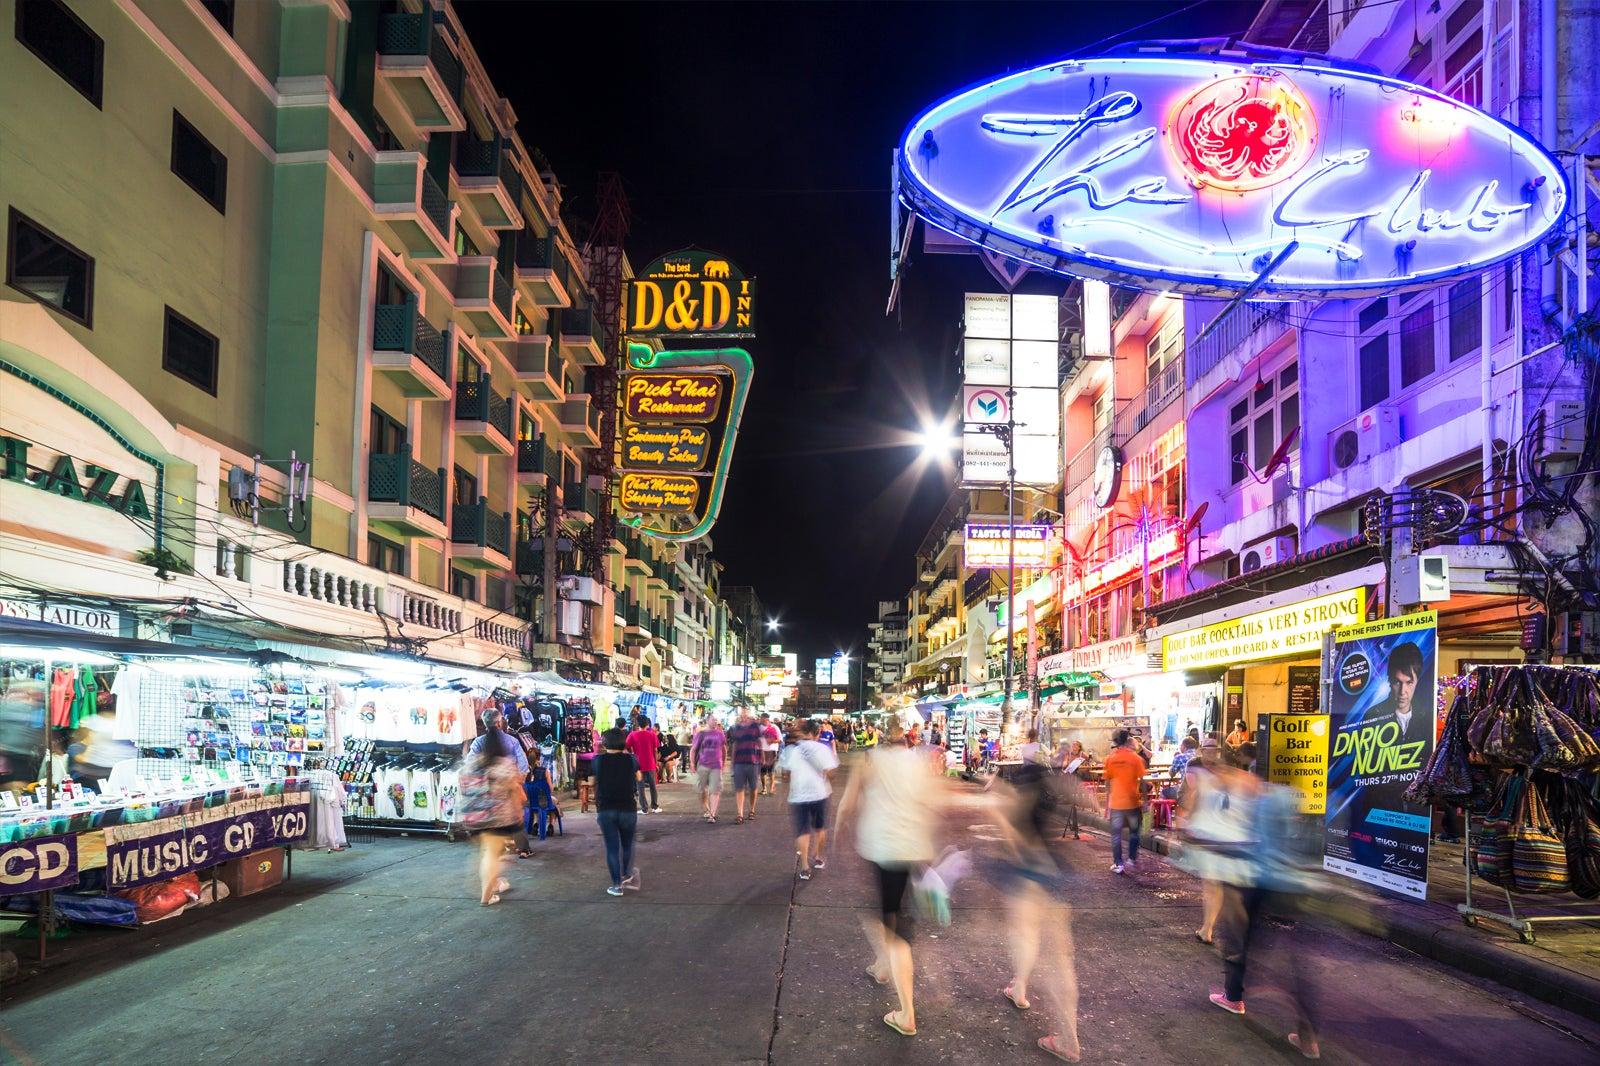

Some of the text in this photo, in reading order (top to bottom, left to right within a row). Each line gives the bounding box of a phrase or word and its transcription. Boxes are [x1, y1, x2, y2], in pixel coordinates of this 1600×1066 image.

[982, 90, 1532, 234] The Club
[664, 262, 691, 273] The best
[631, 279, 731, 332] D&D
[737, 281, 751, 327] INN
[630, 379, 717, 398] Pick-Thai
[638, 397, 707, 414] Restaurant
[626, 427, 706, 447] Swimming Pool
[629, 445, 699, 465] Beauty Salon
[0, 436, 153, 520] LAZA
[627, 476, 696, 496] Thai Massage
[625, 490, 663, 508] Shopping
[1002, 530, 1011, 539] O
[36, 602, 112, 630] TAILOR
[1190, 631, 1207, 647] BAR
[1209, 621, 1263, 644] COCKTAILS
[1267, 610, 1300, 631] VERY
[1303, 597, 1359, 624] STRONG
[1337, 615, 1434, 638] FOR THE FIRST TIME IN ASIA
[1075, 648, 1102, 669] INDIAN
[1108, 640, 1133, 664] FOOD
[1205, 646, 1230, 660] CHECK
[1232, 644, 1242, 656] ID
[1243, 640, 1269, 655] CARD
[1271, 638, 1280, 649] &
[1273, 719, 1311, 733] Golf
[1286, 738, 1312, 750] Bar
[1333, 721, 1400, 758] DARIO
[1275, 754, 1322, 764] Cocktail
[1273, 768, 1324, 777] VERY STRONG
[1354, 771, 1419, 787] THURS 27TH NOV
[1312, 779, 1324, 789] 60
[1308, 803, 1323, 811] 200
[0, 841, 70, 886] CD
[112, 833, 208, 886] MUSIC
[224, 821, 255, 854] CD
[1397, 858, 1422, 870] Club
